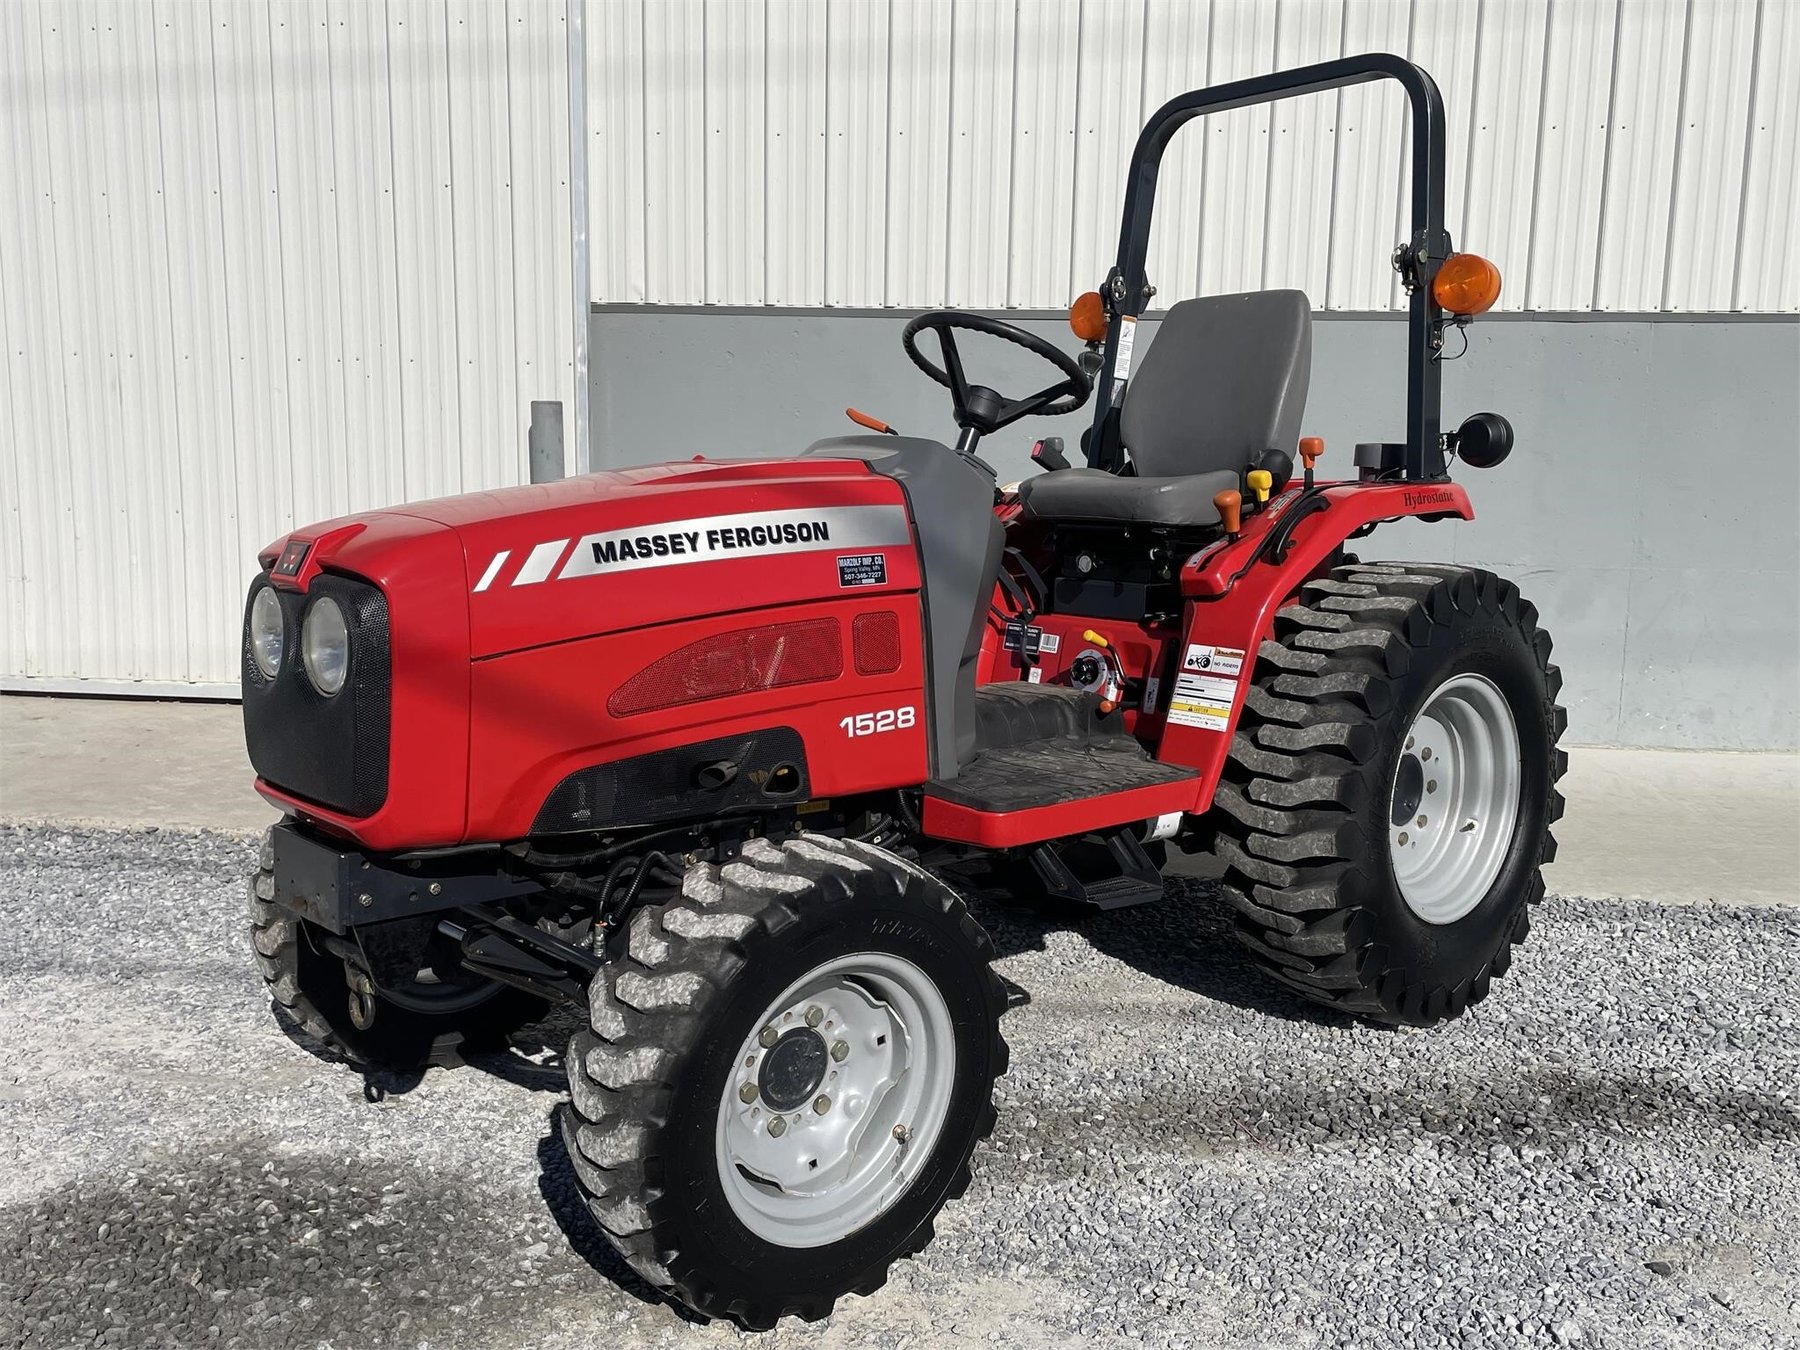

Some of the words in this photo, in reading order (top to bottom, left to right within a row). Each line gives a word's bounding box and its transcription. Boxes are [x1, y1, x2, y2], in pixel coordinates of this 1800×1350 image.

[1403, 490, 1454, 509] Hydrostatic
[591, 531, 701, 564] MASSEY
[706, 521, 830, 549] FERGUSON
[839, 706, 916, 738] 1528
